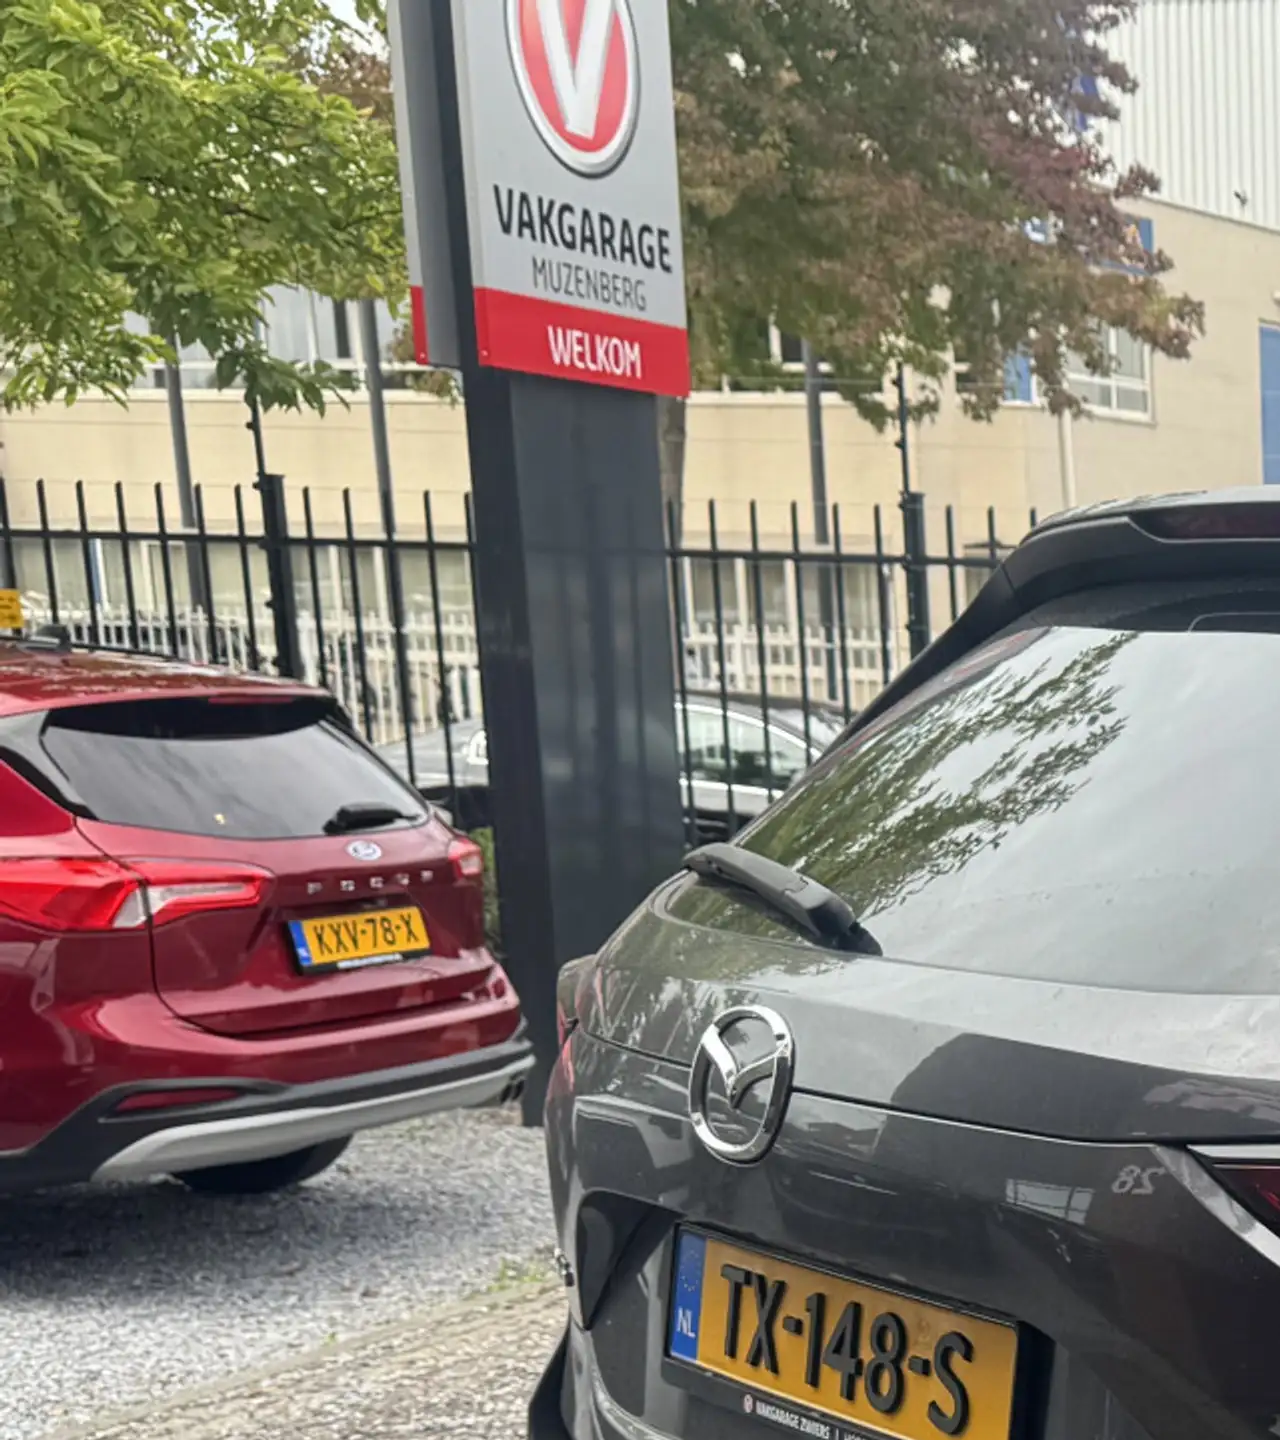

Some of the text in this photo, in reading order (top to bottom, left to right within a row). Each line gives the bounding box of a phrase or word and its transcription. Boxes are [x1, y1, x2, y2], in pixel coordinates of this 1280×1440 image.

[493, 183, 673, 274] VAKGARAGE
[546, 324, 643, 380] WELKOM
[312, 911, 420, 956] KXV-78-X
[676, 1305, 697, 1339] NL
[719, 1262, 974, 1437] TX-148-S
